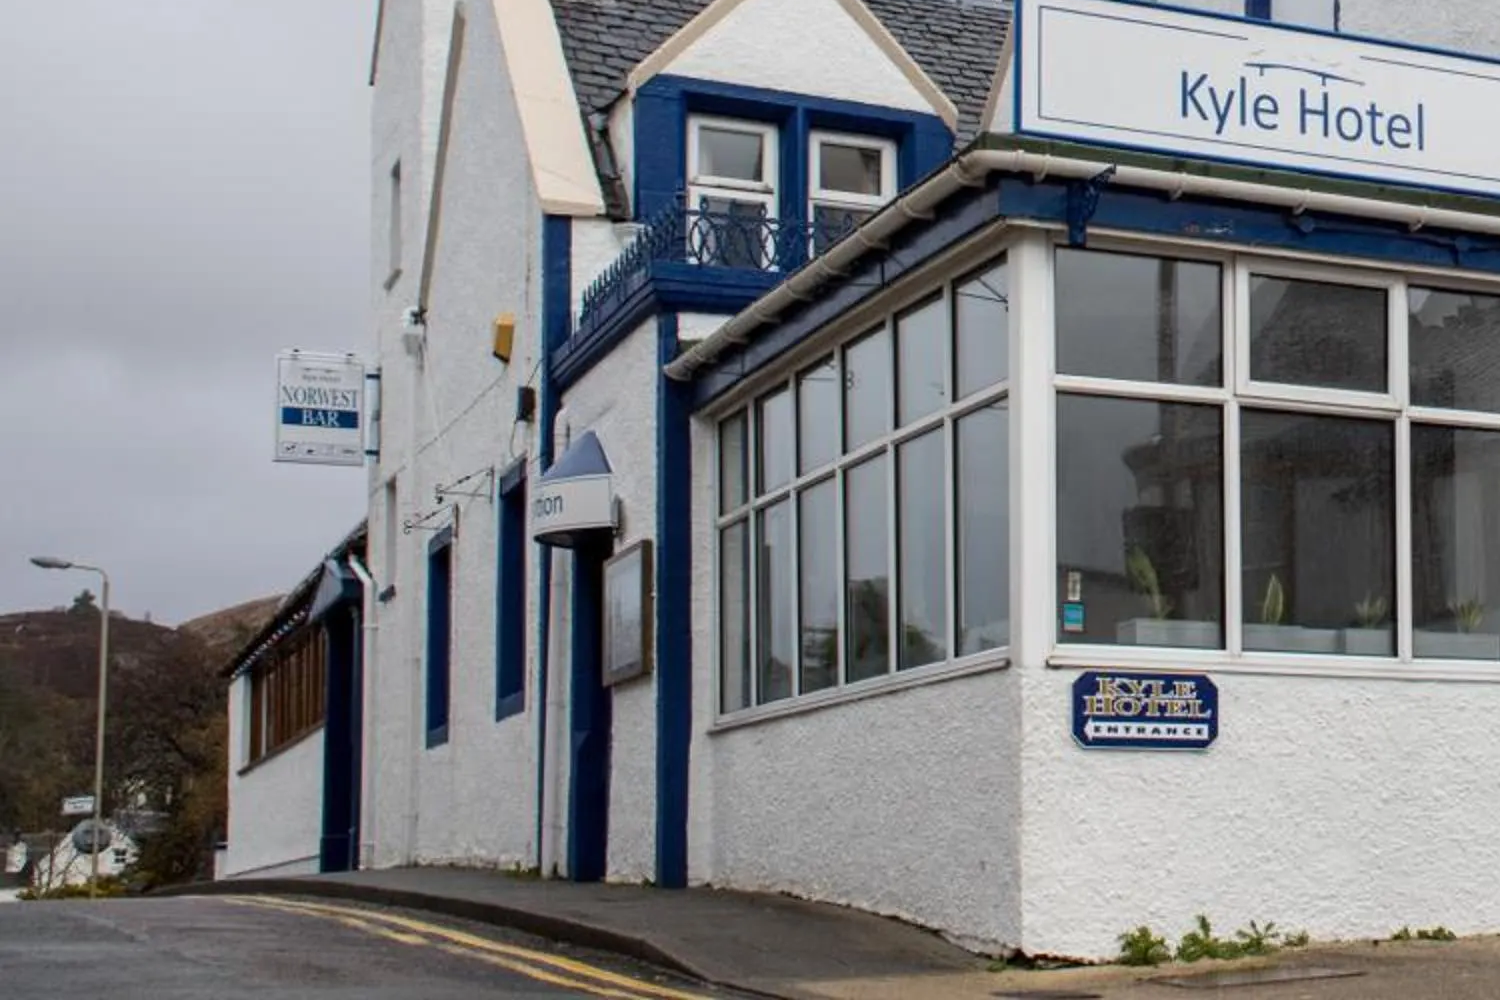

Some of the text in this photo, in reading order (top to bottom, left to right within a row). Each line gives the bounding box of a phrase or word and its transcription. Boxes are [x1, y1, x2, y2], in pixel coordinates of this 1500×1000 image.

[1180, 70, 1425, 151] Kyle Hotel
[282, 386, 358, 409] NORWEST
[302, 409, 340, 427] BAR
[1096, 677, 1197, 699] KYLE
[1083, 695, 1212, 718] HOTEL
[1093, 725, 1205, 736] ENTRANCE
